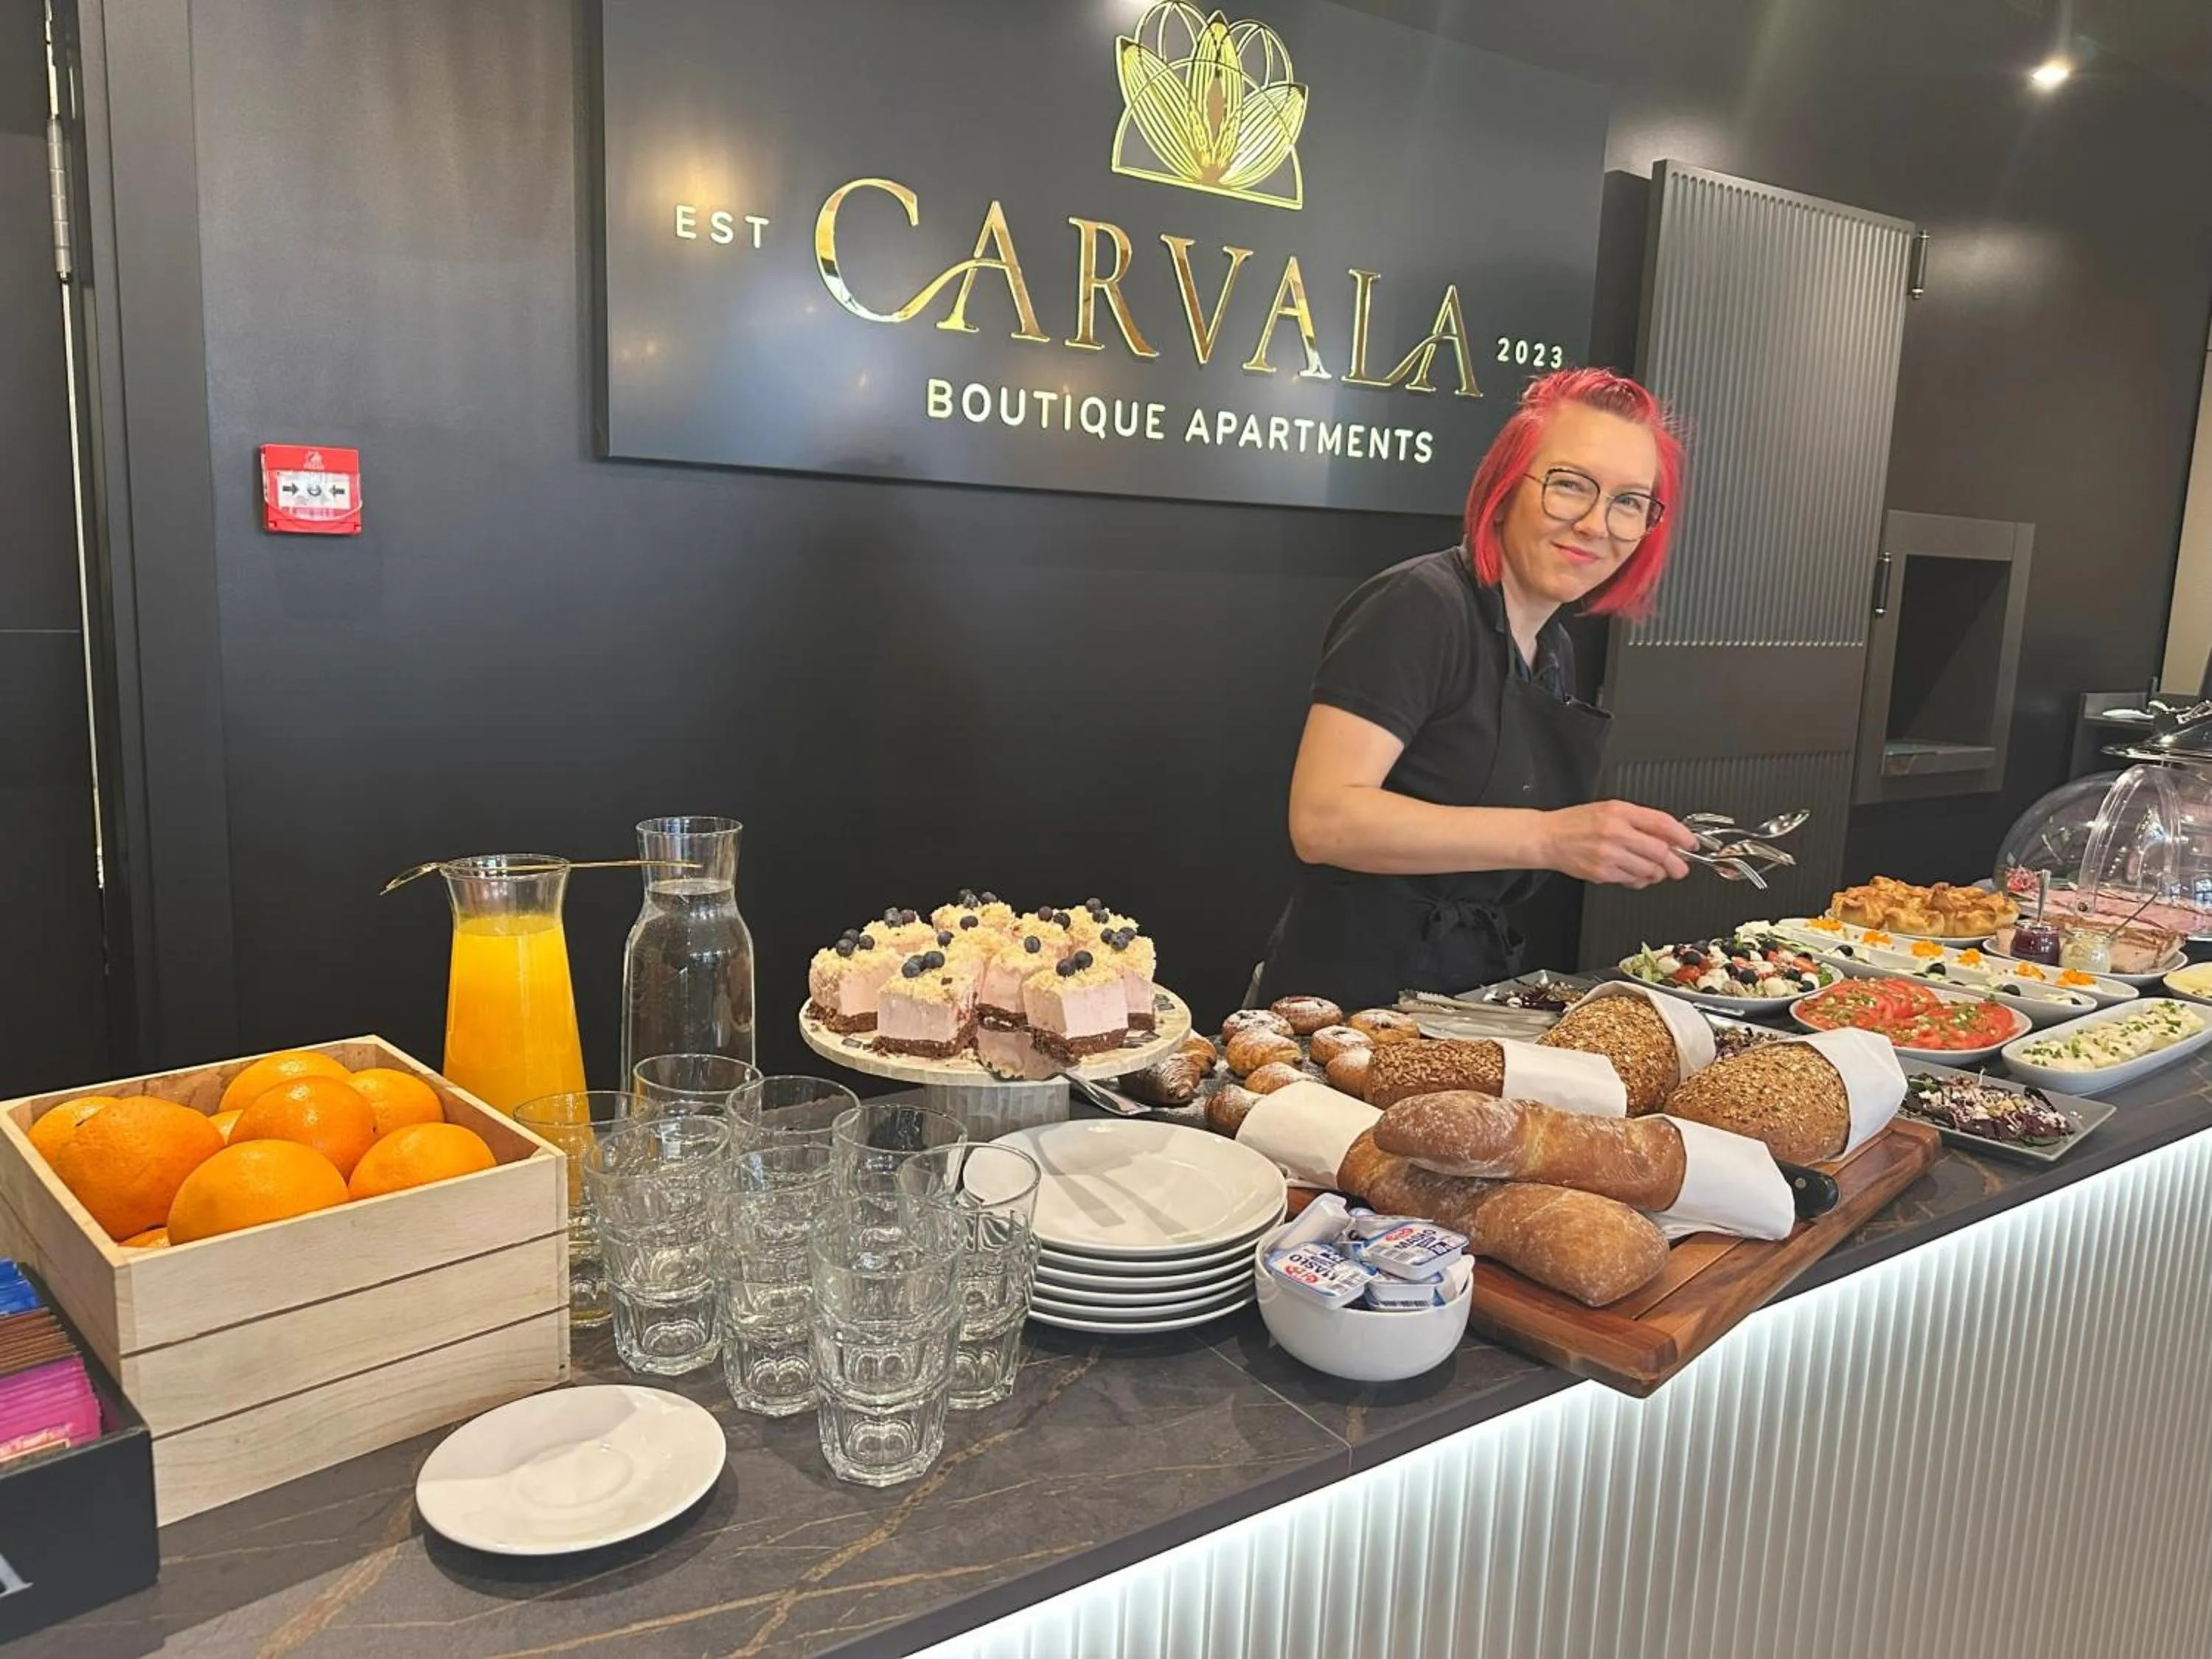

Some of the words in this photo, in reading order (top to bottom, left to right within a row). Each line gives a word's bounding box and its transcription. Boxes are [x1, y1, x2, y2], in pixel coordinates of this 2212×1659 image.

[675, 204, 769, 248] EST
[814, 177, 1484, 397] CARVALA
[1496, 337, 1564, 369] 2023
[926, 378, 1166, 440] BOUTIQUE
[1184, 408, 1434, 464] APARTMENTS
